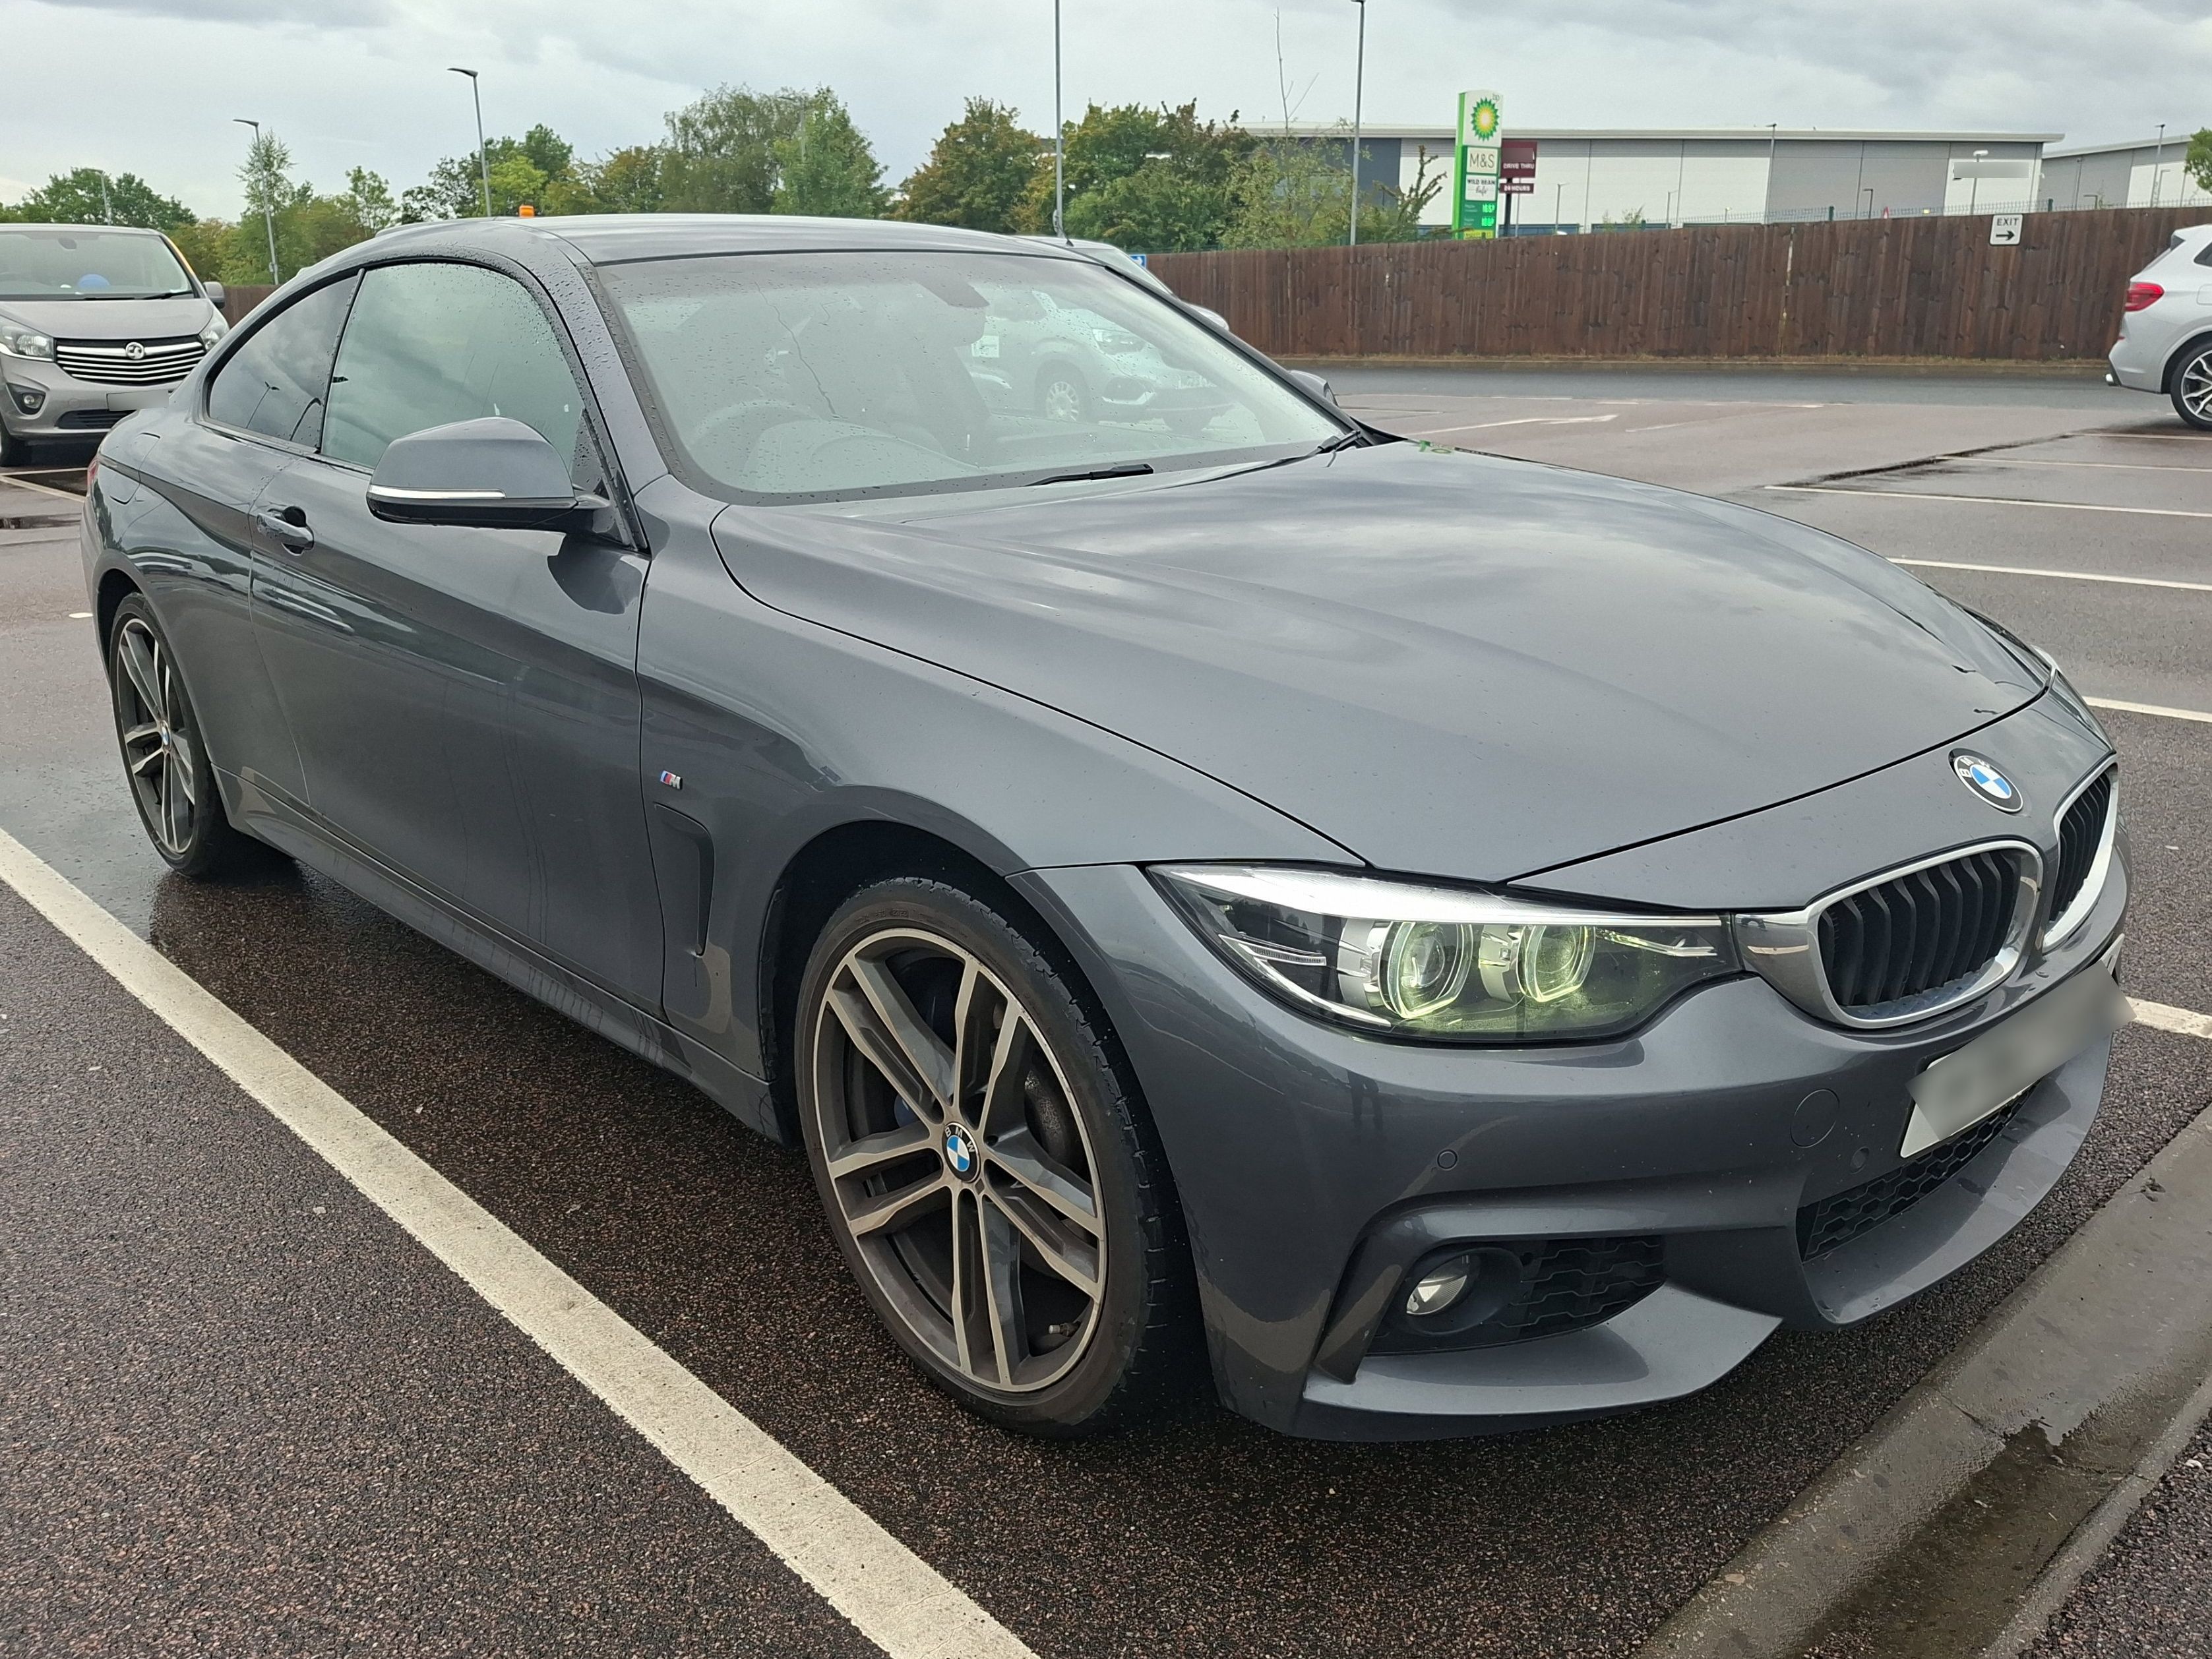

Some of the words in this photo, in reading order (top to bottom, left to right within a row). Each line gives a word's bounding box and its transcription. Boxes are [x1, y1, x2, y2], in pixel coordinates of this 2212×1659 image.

[1470, 153, 1494, 168] M&S
[1997, 218, 2019, 226] EXIT
[945, 1126, 975, 1153] BMW
